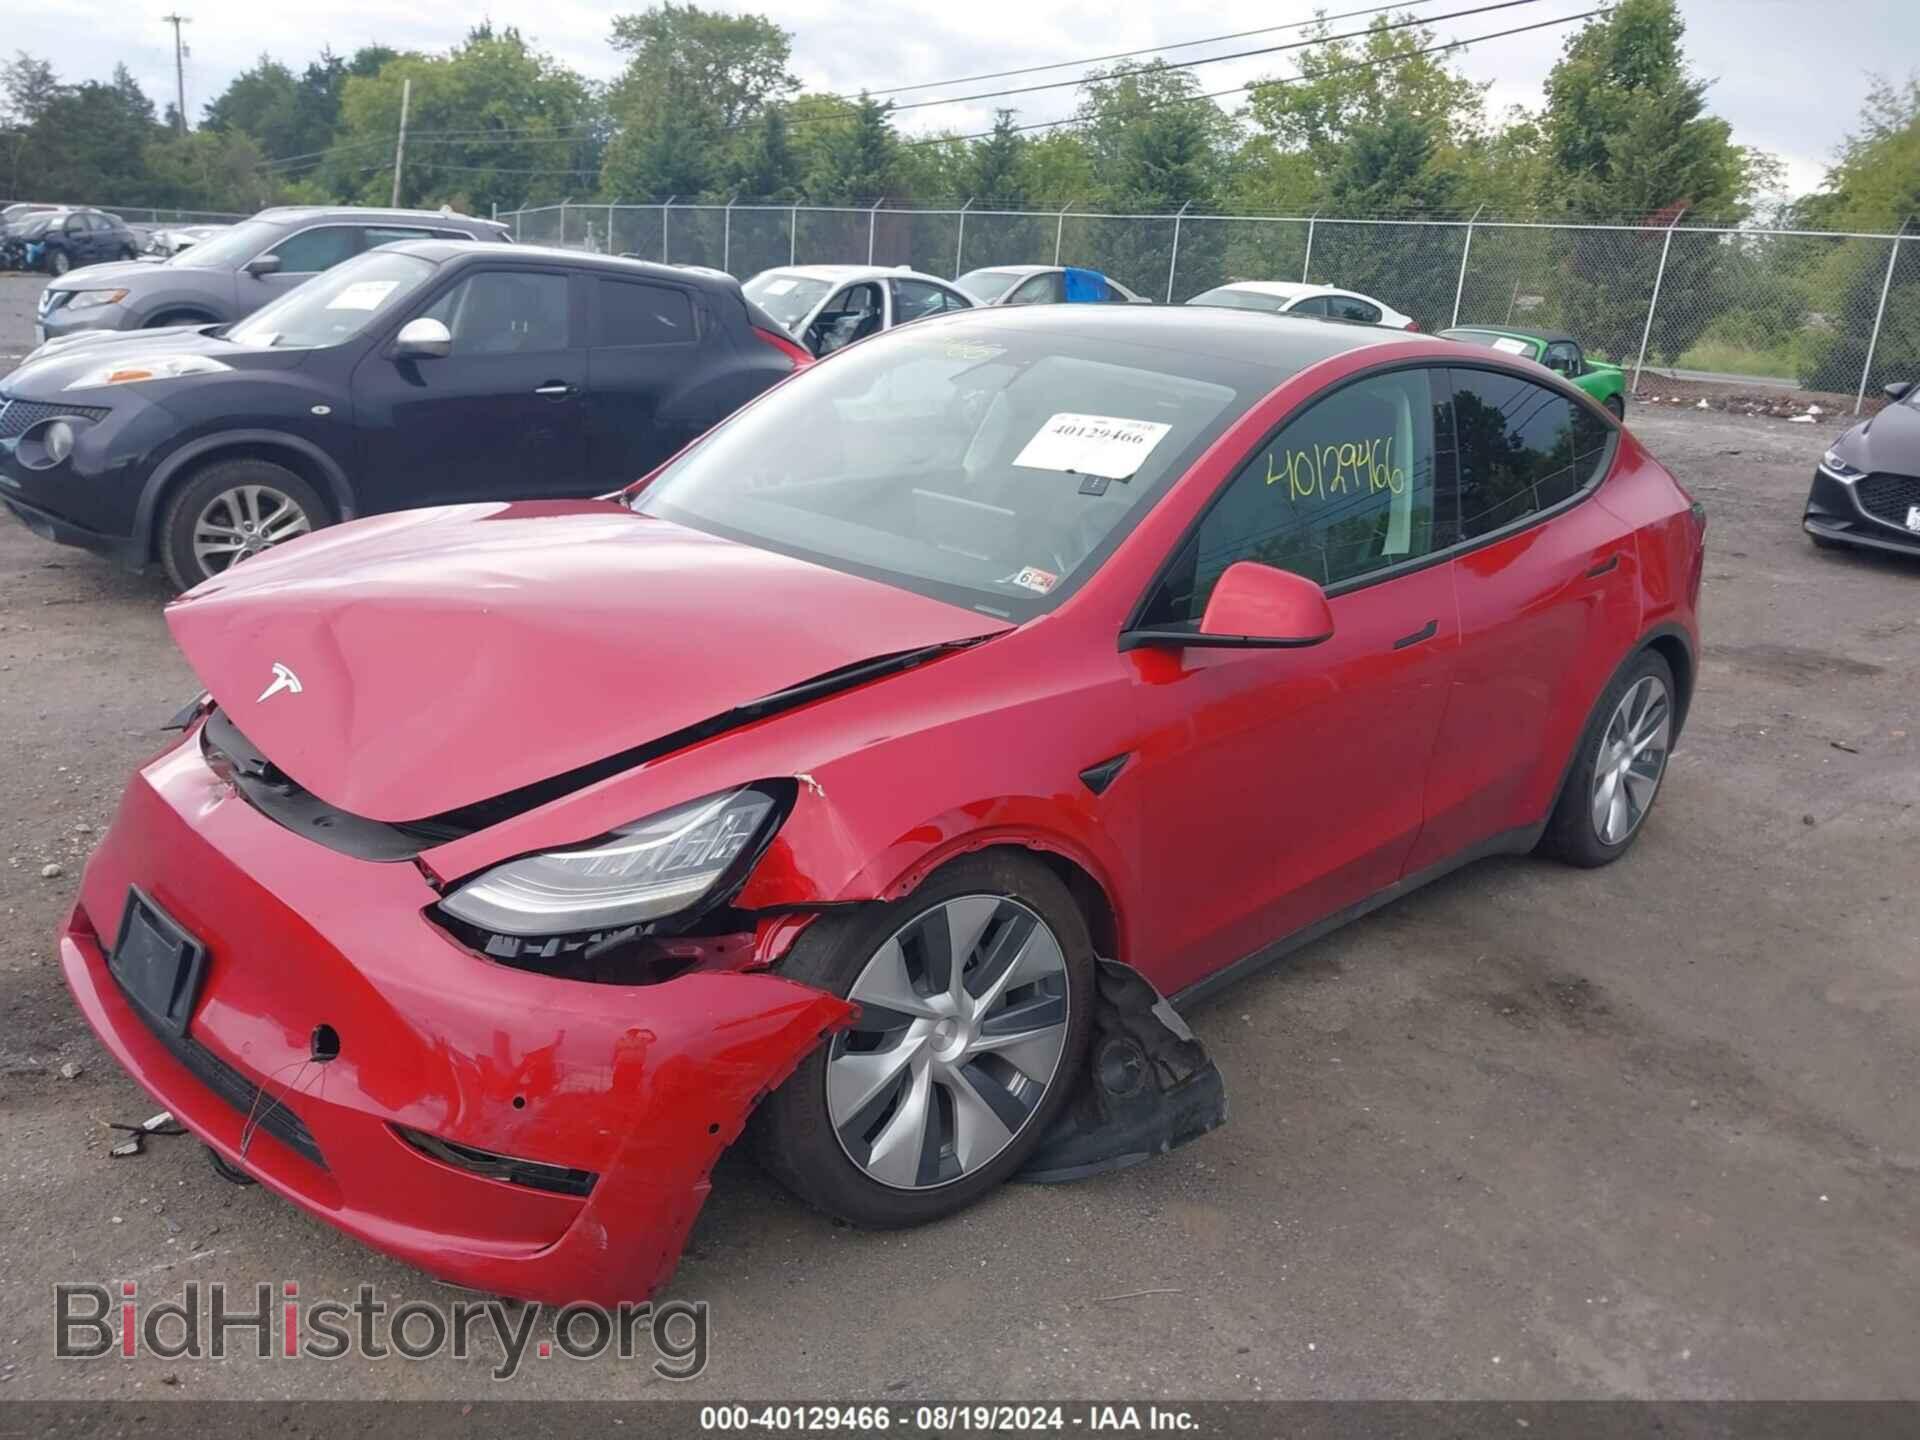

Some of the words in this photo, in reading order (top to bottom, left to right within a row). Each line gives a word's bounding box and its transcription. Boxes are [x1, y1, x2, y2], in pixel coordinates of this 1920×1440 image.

[1053, 424, 1144, 445] 40129466
[1266, 436, 1405, 502] 40129466
[1020, 572, 1032, 583] 6
